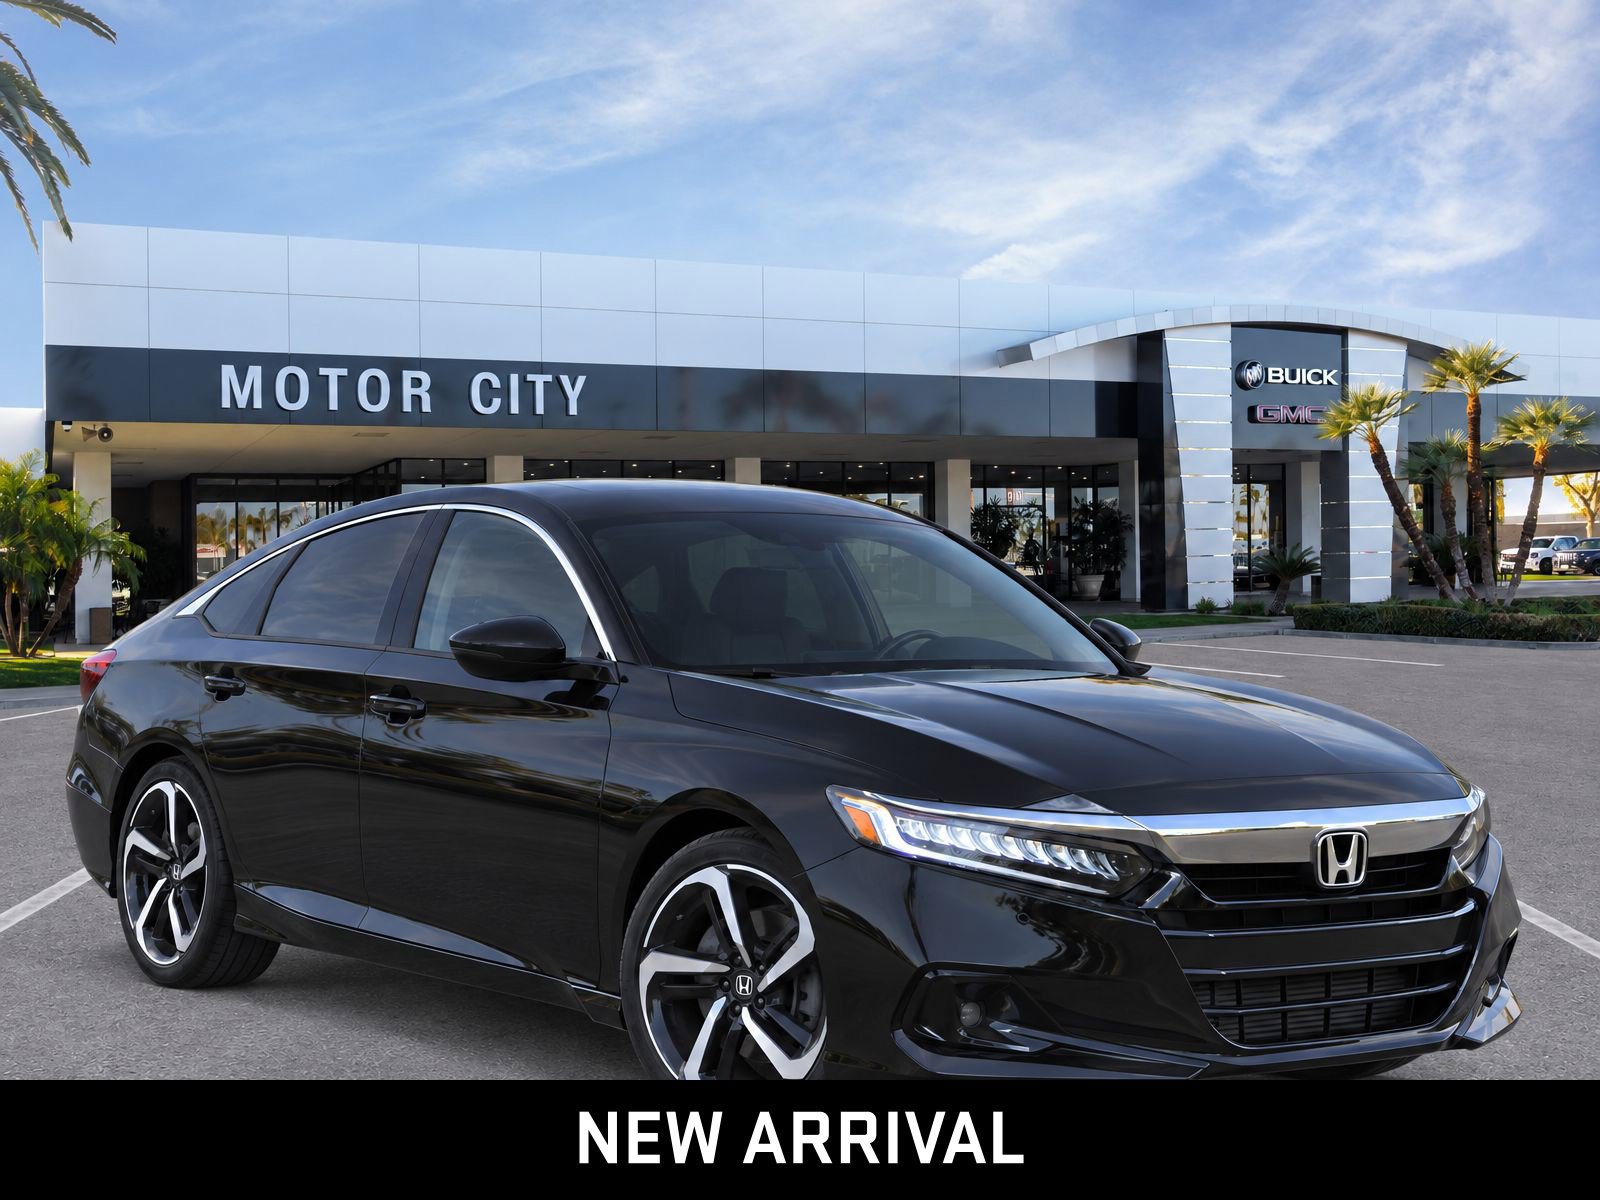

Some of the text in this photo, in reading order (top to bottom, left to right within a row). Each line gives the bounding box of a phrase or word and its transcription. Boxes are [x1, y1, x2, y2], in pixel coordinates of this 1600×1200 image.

[1267, 367, 1339, 385] BUICK
[220, 363, 587, 417] MOTOR CITY
[1257, 405, 1328, 423] GMC
